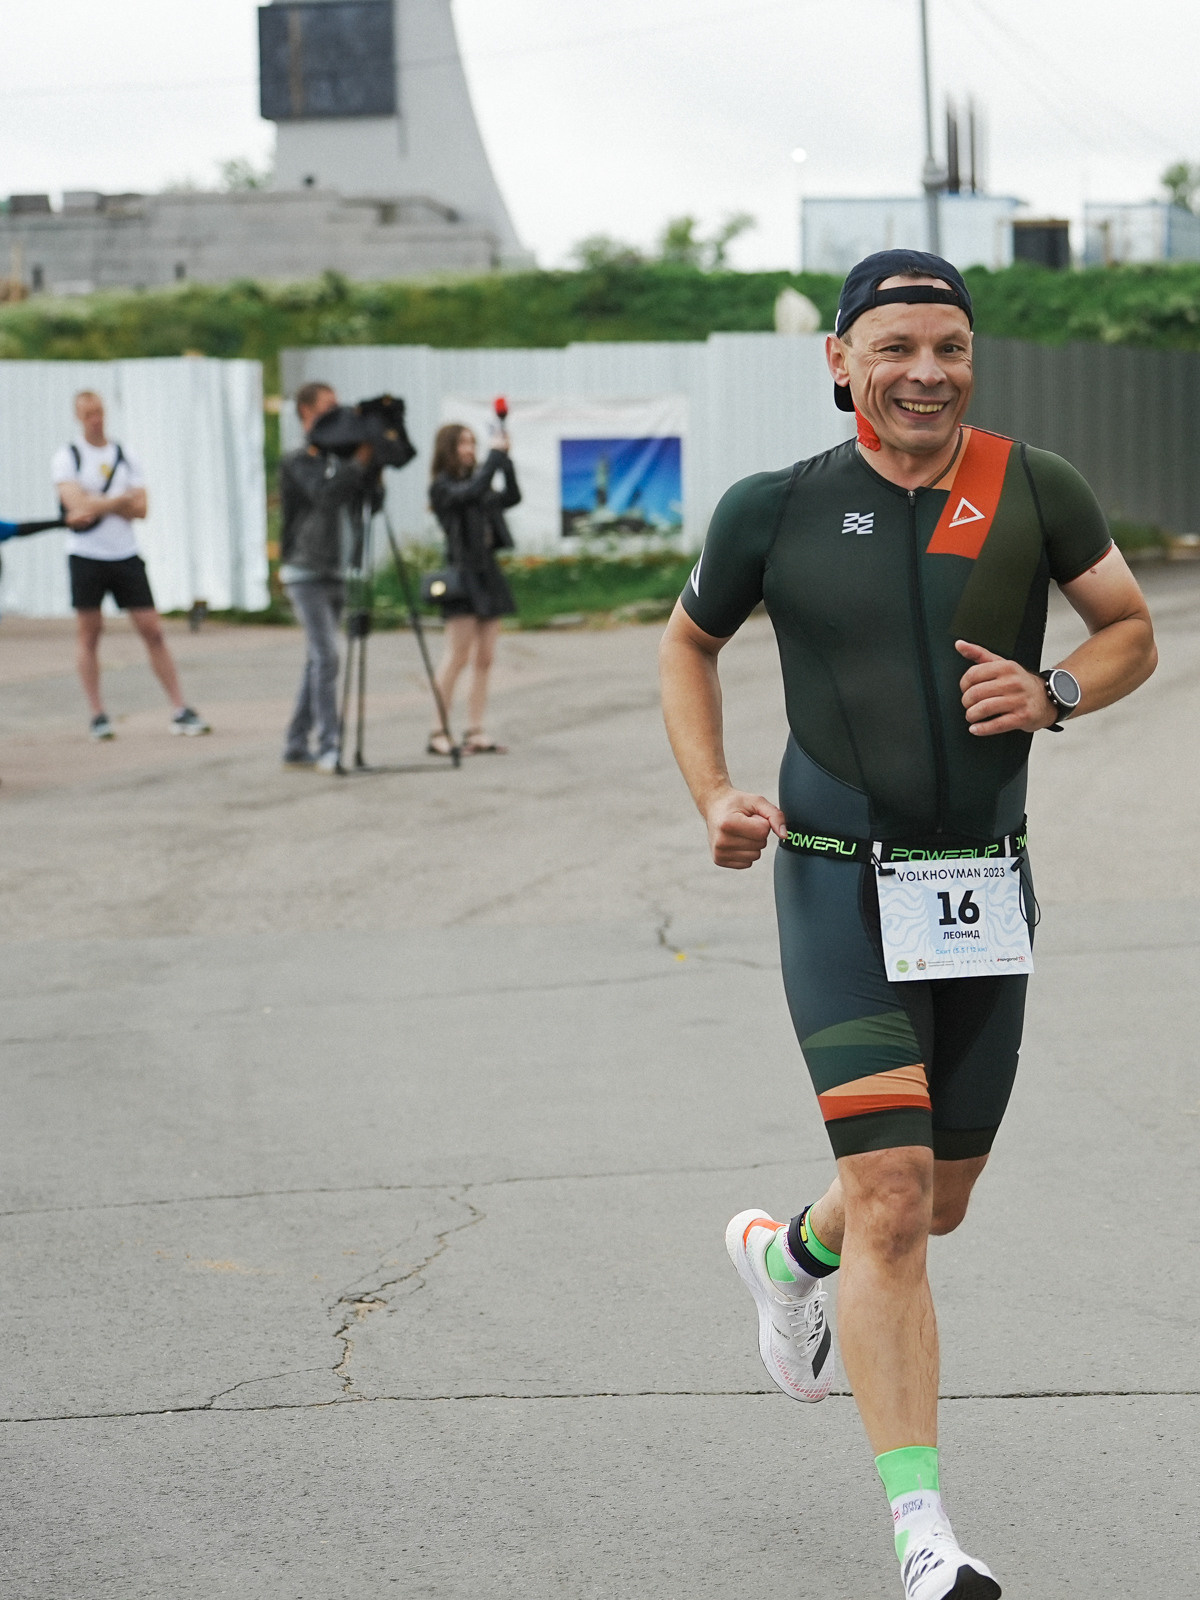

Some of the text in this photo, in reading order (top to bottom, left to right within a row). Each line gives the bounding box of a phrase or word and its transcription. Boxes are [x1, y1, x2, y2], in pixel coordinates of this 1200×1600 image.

[897, 867, 1005, 882] VOLKHOVMAN 2023
[937, 890, 980, 926] 16
[943, 930, 980, 940] ЛЕОНИД
